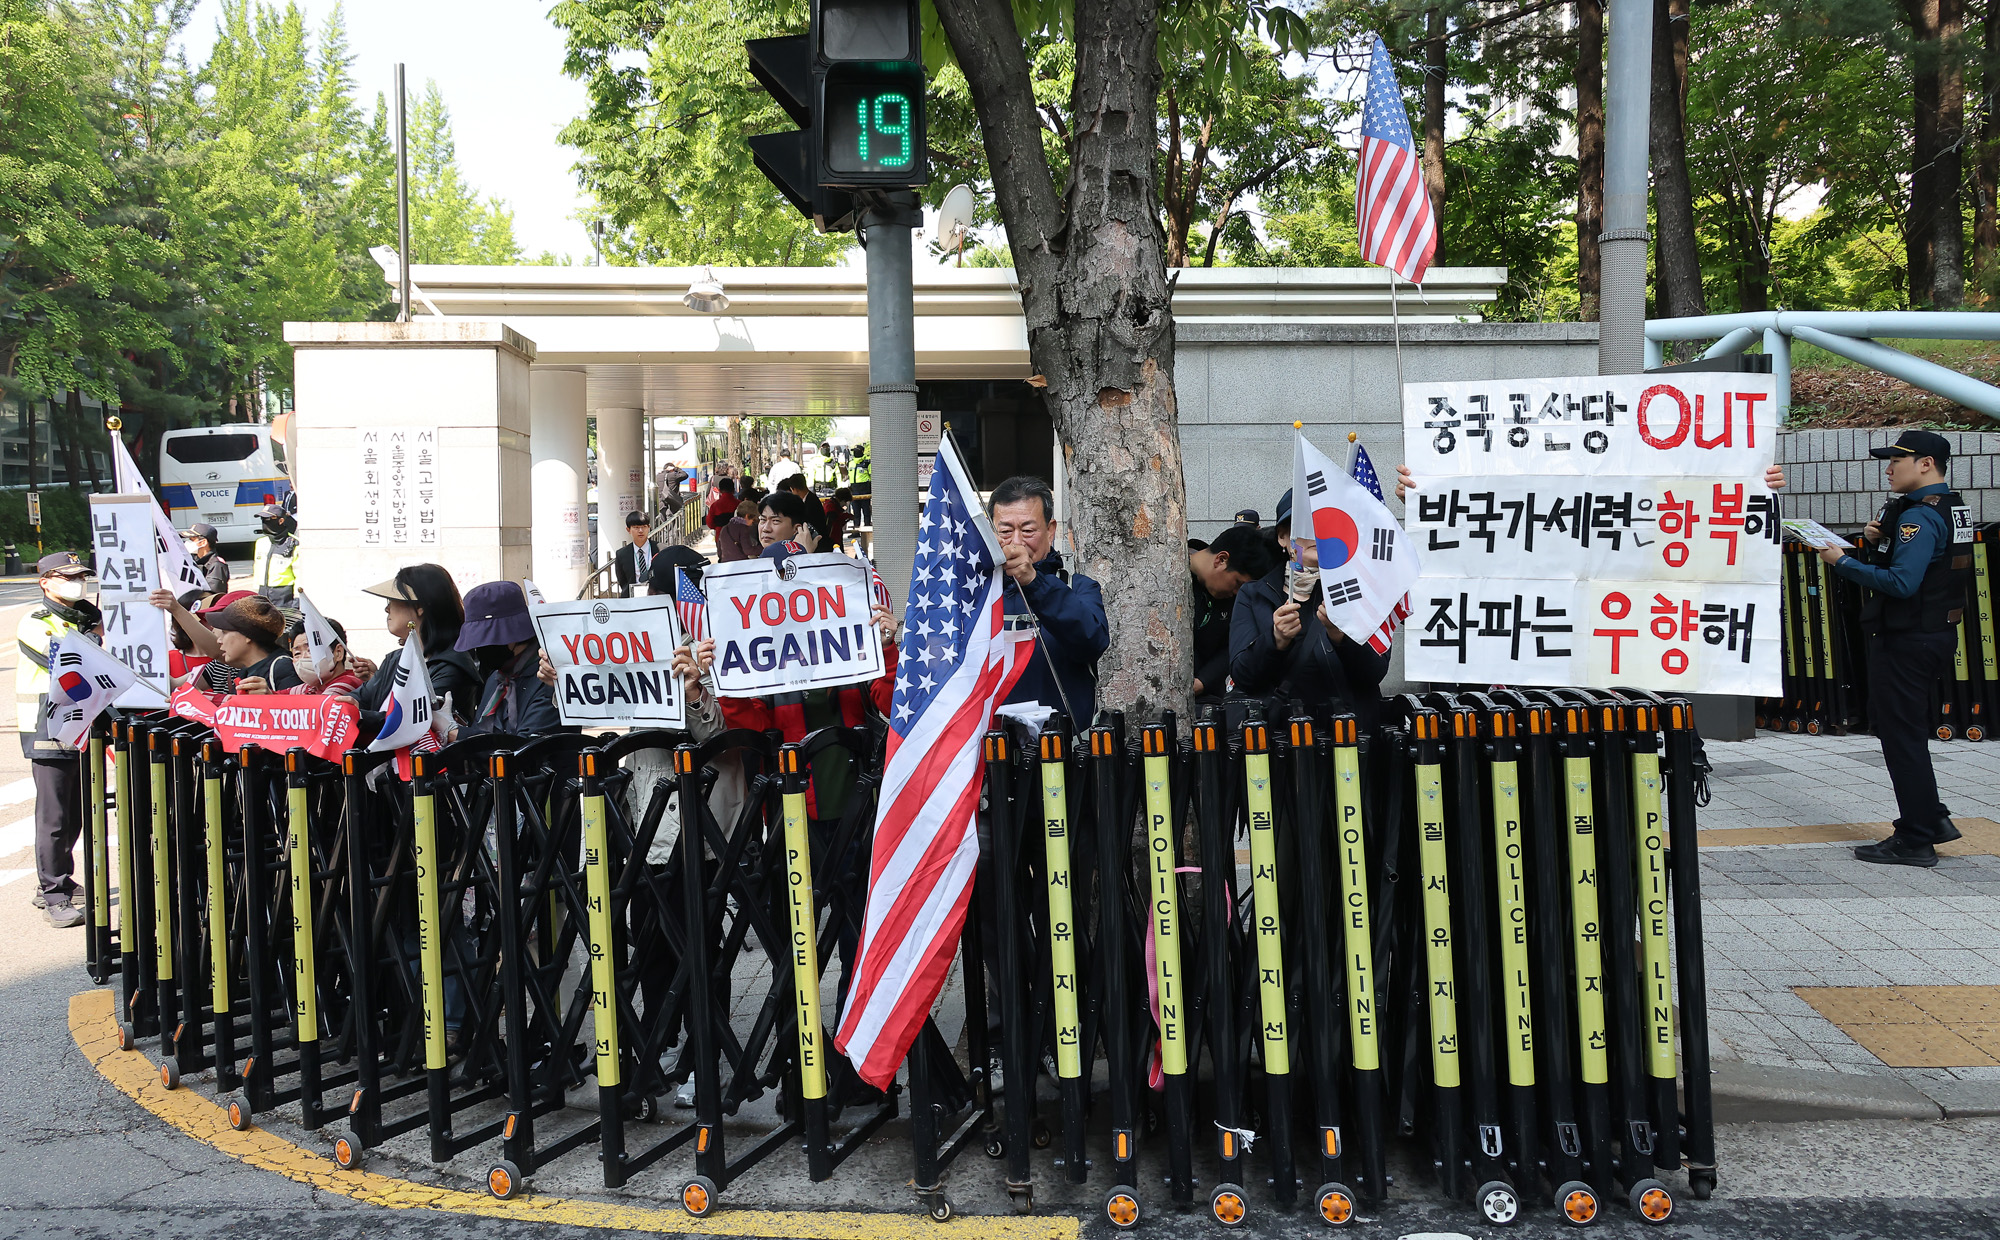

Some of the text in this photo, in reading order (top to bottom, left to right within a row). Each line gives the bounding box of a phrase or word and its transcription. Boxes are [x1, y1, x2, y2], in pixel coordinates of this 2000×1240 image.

[857, 94, 911, 166] 19
[1424, 384, 1768, 454] 중국공산당 OUT
[200, 489, 230, 498] POLICE
[363, 431, 380, 543] 서울회생법원
[390, 431, 407, 543] 서울중앙지방법원
[418, 430, 435, 543] 서울고등법원
[1953, 510, 1972, 528] 경찰
[93, 512, 127, 552] 님,
[1956, 530, 1973, 540] POLICE
[100, 556, 147, 593] 스런
[730, 585, 847, 630] YOON
[103, 601, 131, 635] 가
[561, 631, 655, 665] YOON
[720, 623, 868, 677] AGAIN!
[1420, 592, 1573, 664] 좌파는
[1593, 591, 1756, 675] 우향해
[1975, 567, 1994, 667] 질서유지선
[215, 706, 268, 731] ONLY,
[269, 708, 316, 730] YOON!
[320, 702, 343, 747] AGAIN
[332, 713, 352, 746] 2025
[565, 669, 674, 707] AGAIN!
[416, 845, 432, 1040] POLICE LINE
[585, 848, 610, 1057] 질서유지선
[789, 849, 814, 1067] POLICE LINE
[1047, 818, 1077, 1046] 질서유지선
[1153, 815, 1177, 1041] POLICE LINE
[1252, 811, 1284, 1041] 질서유지선
[1343, 805, 1371, 1035] POLICE LINE
[1424, 821, 1457, 1054] 질서유지선
[1505, 820, 1532, 1051] POLICE LINE
[1574, 815, 1606, 1050] 질서유지선
[1645, 812, 1669, 1044] POLICE LINE
